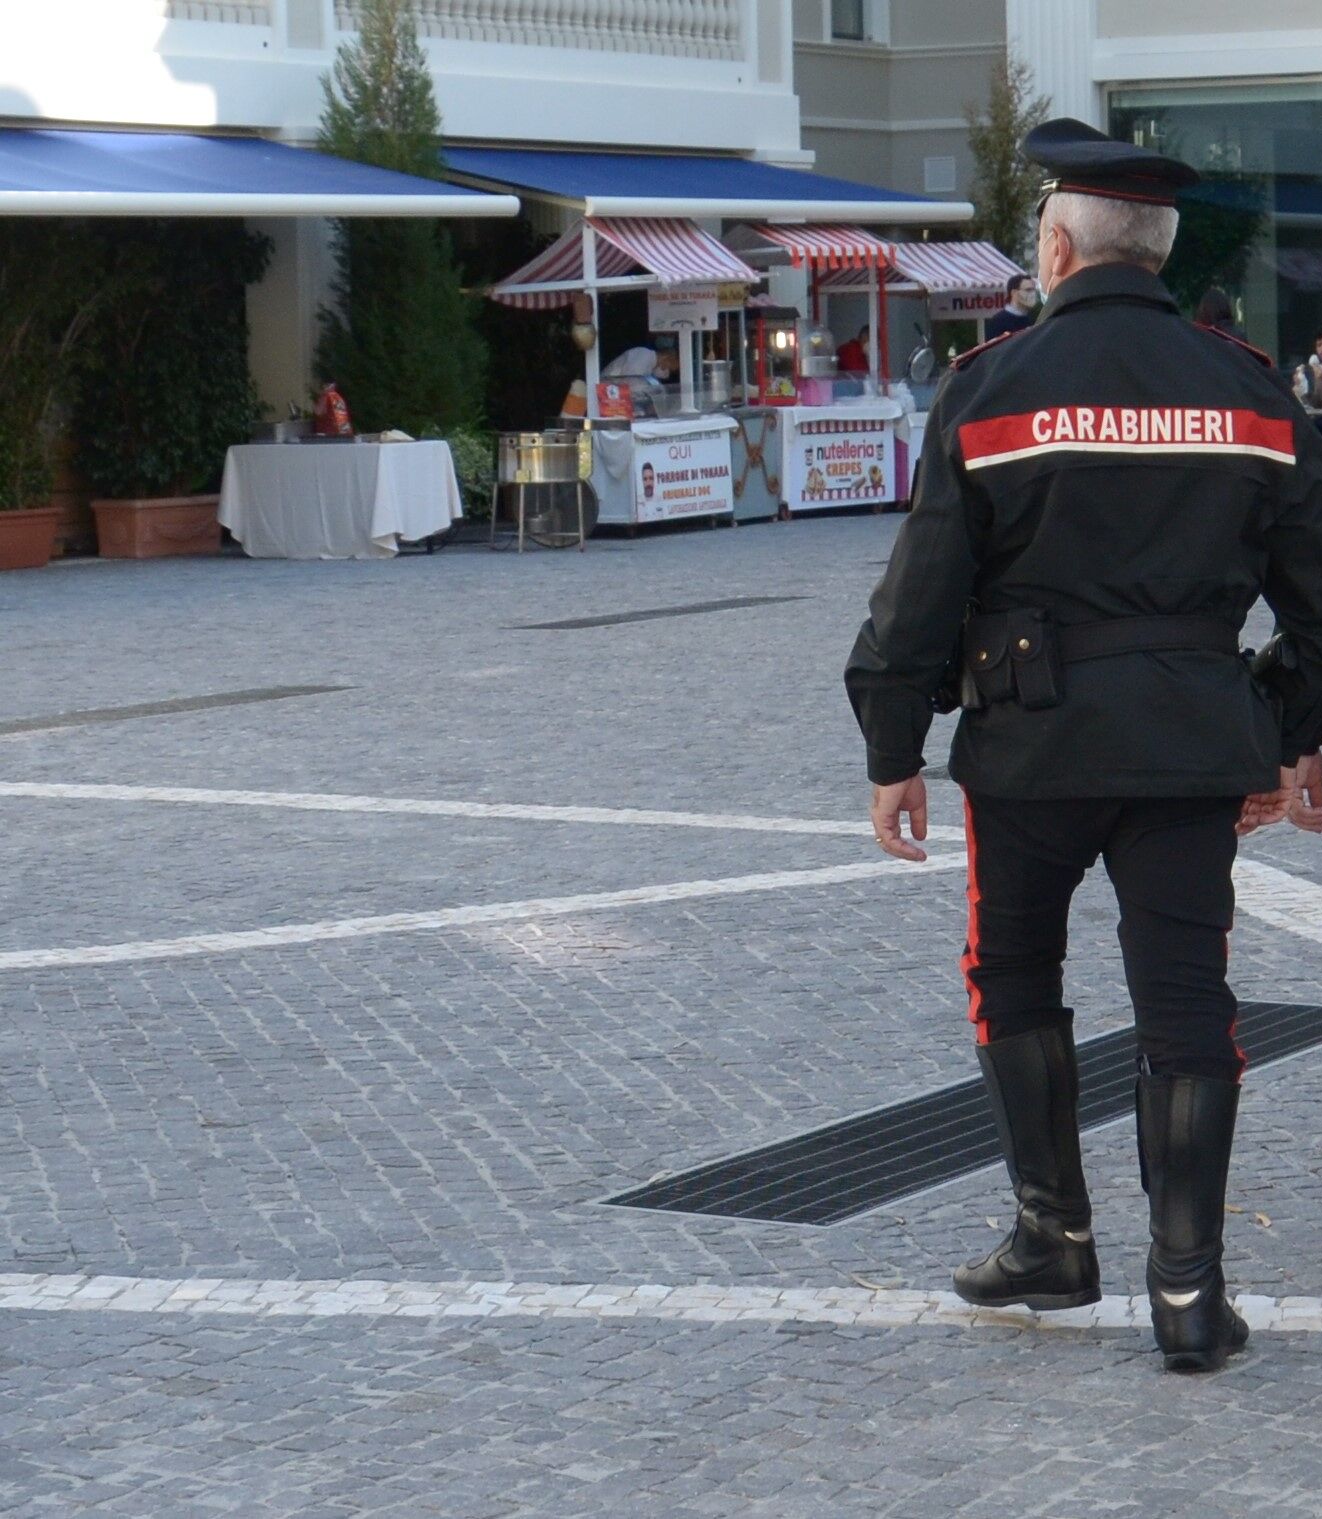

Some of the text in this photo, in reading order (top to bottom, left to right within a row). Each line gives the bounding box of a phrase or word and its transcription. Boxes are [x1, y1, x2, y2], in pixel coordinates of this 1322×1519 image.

[1032, 408, 1234, 443] CARABINIERI
[669, 445, 692, 460] QUI
[817, 439, 874, 460] nutelleria
[691, 468, 699, 480] DI
[826, 462, 862, 477] CREPES
